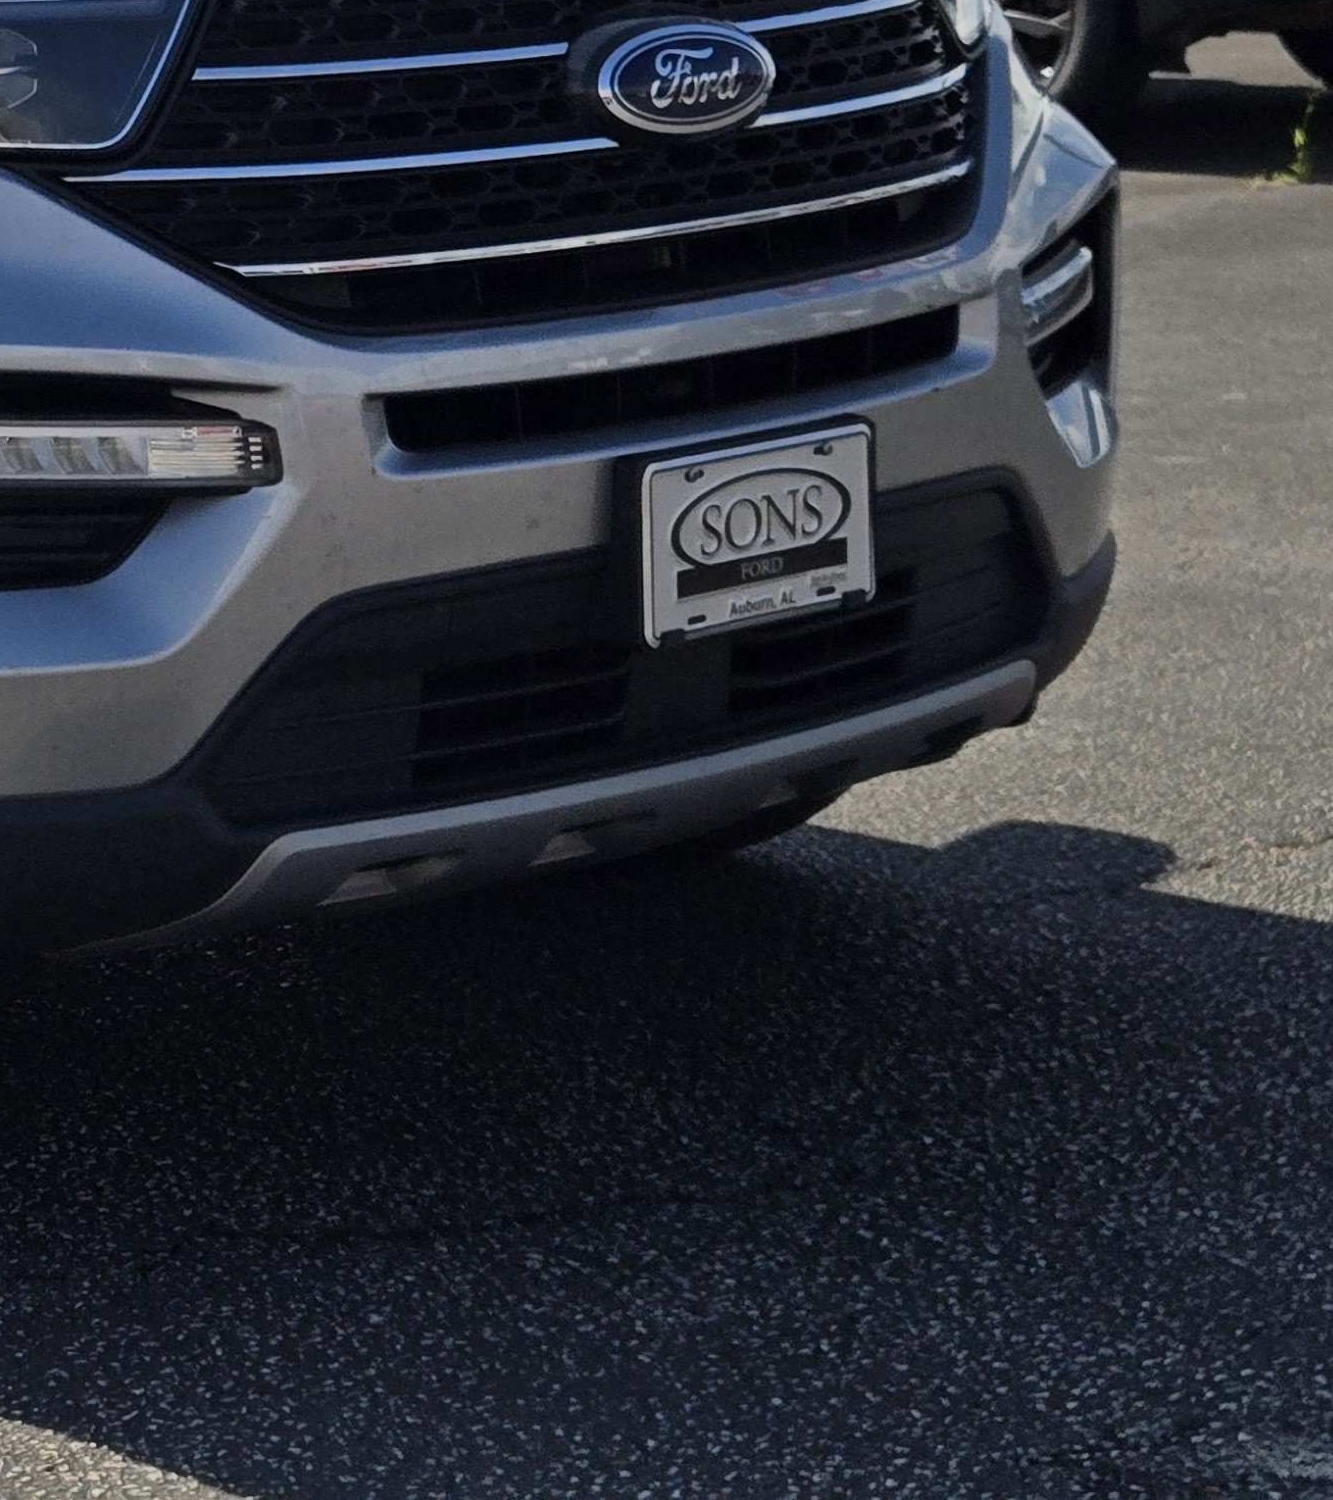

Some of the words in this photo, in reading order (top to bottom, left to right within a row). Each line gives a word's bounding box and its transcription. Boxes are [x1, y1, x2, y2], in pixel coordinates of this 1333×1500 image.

[650, 46, 743, 109] Ford
[700, 484, 824, 559] SONS
[740, 557, 783, 580] FORD
[780, 589, 797, 605] AL
